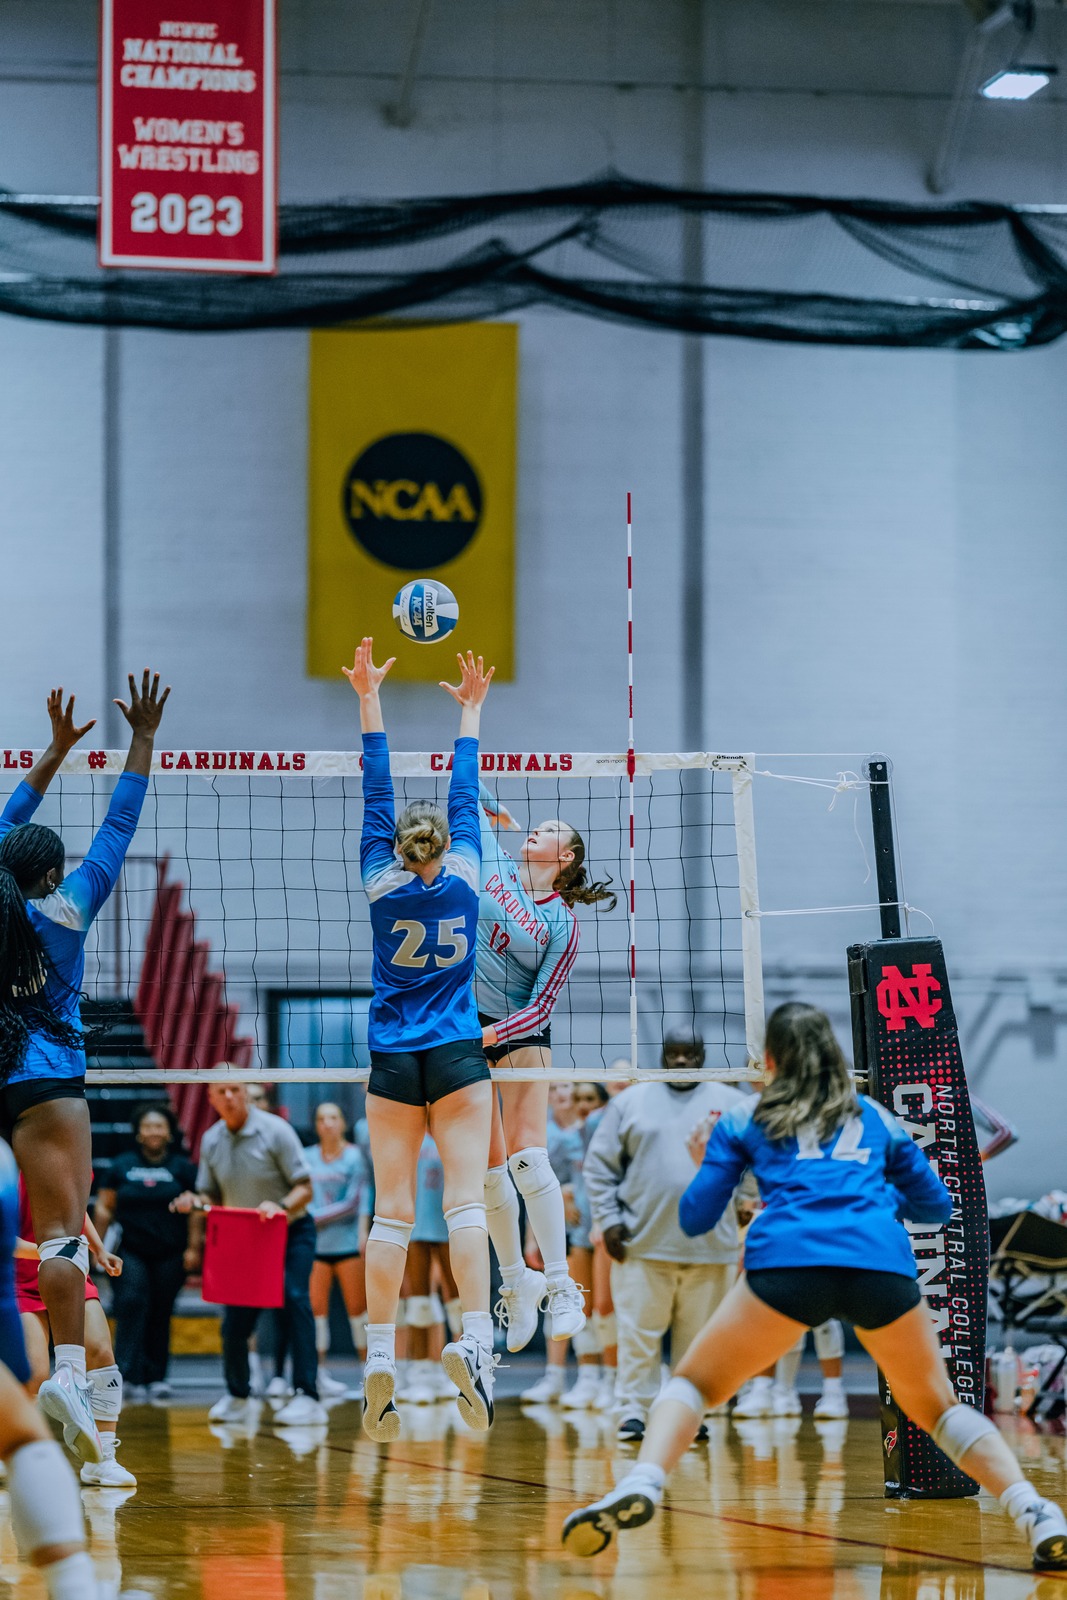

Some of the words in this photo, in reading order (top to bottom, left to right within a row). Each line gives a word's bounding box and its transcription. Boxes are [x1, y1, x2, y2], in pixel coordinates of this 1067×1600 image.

[122, 38, 243, 67] NATIONAL
[120, 64, 257, 93] CHAMPIONS
[133, 117, 245, 146] WOMEN'S
[117, 144, 260, 175] WRESTLING
[130, 192, 243, 237] 2023
[351, 479, 477, 522] NCAA
[425, 591, 435, 628] molten
[161, 751, 306, 770] CARDINALS
[430, 753, 573, 772] CDINALS
[485, 874, 549, 946] CARDINALS
[390, 915, 469, 968] 25
[489, 923, 511, 957] 12
[935, 1084, 959, 1164] NORTH
[943, 1175, 967, 1285] CENTRAL
[951, 1297, 976, 1405] COLLEGE
